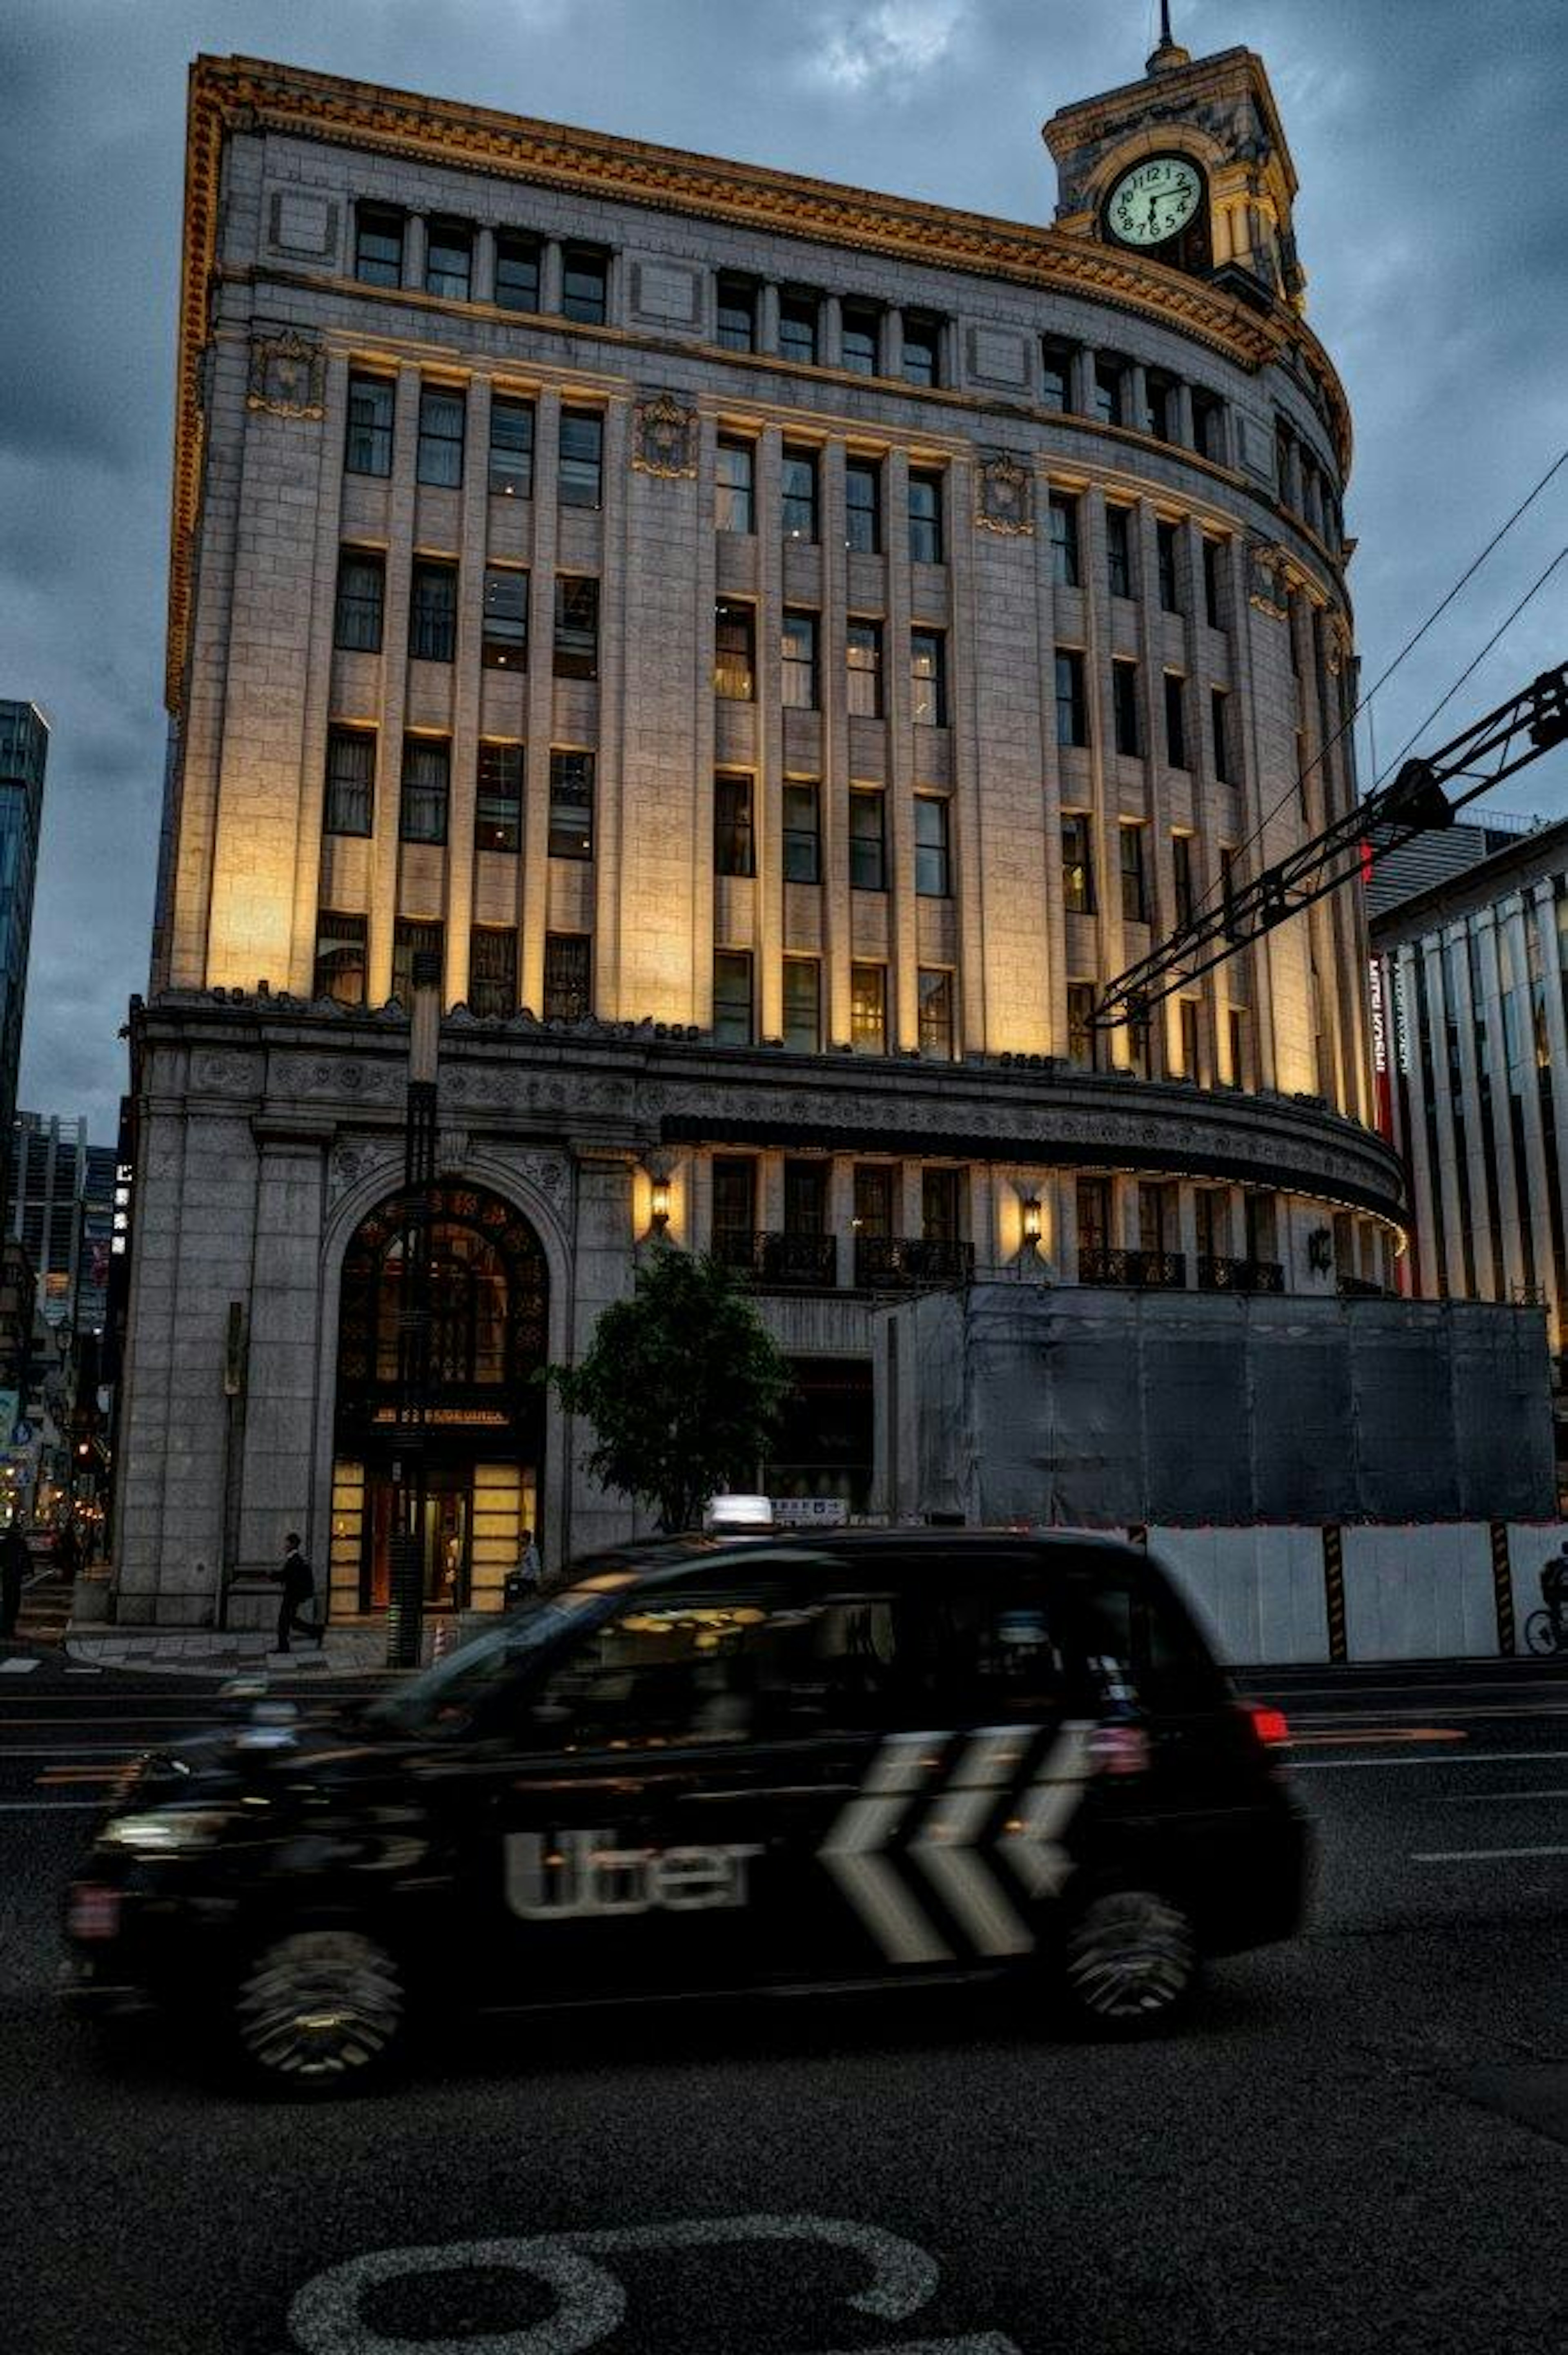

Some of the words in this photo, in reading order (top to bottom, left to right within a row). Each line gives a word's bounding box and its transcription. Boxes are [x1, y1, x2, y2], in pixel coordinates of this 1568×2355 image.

[1147, 168, 1160, 181] 12
[1166, 168, 1170, 179] 1
[1176, 173, 1185, 186] 2
[1132, 177, 1143, 188] 11
[1122, 191, 1134, 203] 10
[1118, 207, 1128, 219] 9
[1177, 203, 1186, 213] 4
[1123, 218, 1133, 230] 8
[1166, 215, 1175, 228] 5
[1136, 224, 1145, 236] 7
[1150, 222, 1161, 236] 6
[502, 1828, 767, 1921] Uber
